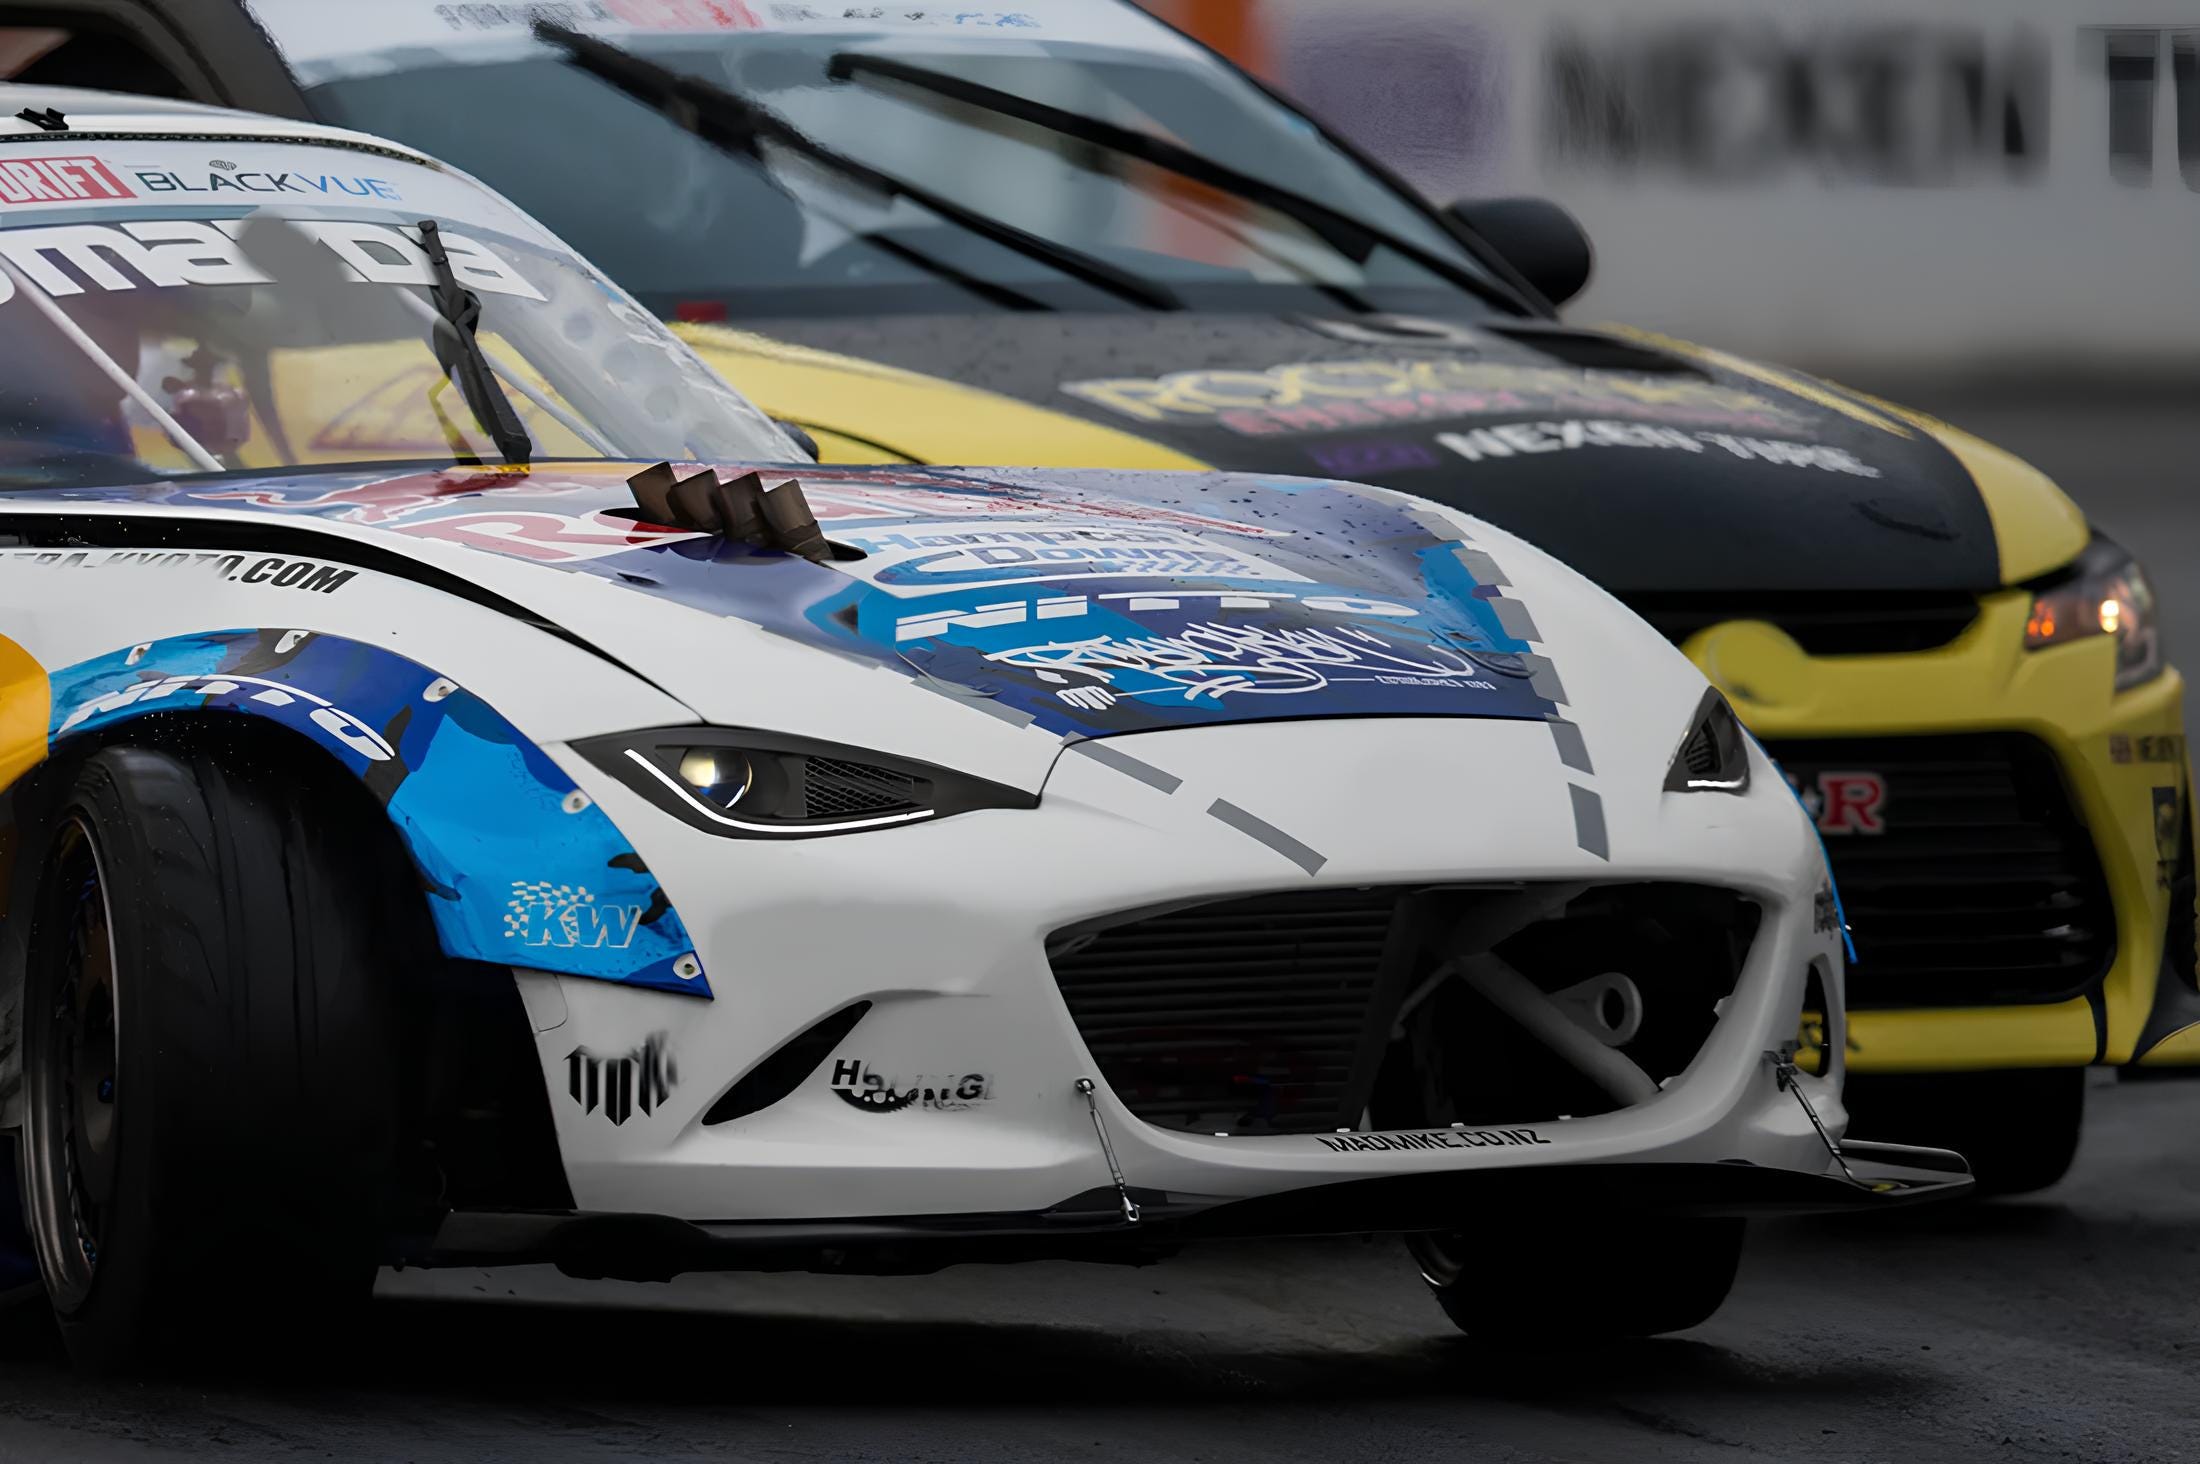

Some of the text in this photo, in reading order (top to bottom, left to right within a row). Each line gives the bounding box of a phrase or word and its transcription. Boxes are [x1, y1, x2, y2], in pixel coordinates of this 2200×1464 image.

[135, 171, 402, 200] BLACKVUE
[0, 219, 549, 298] mada
[525, 902, 642, 948] KW
